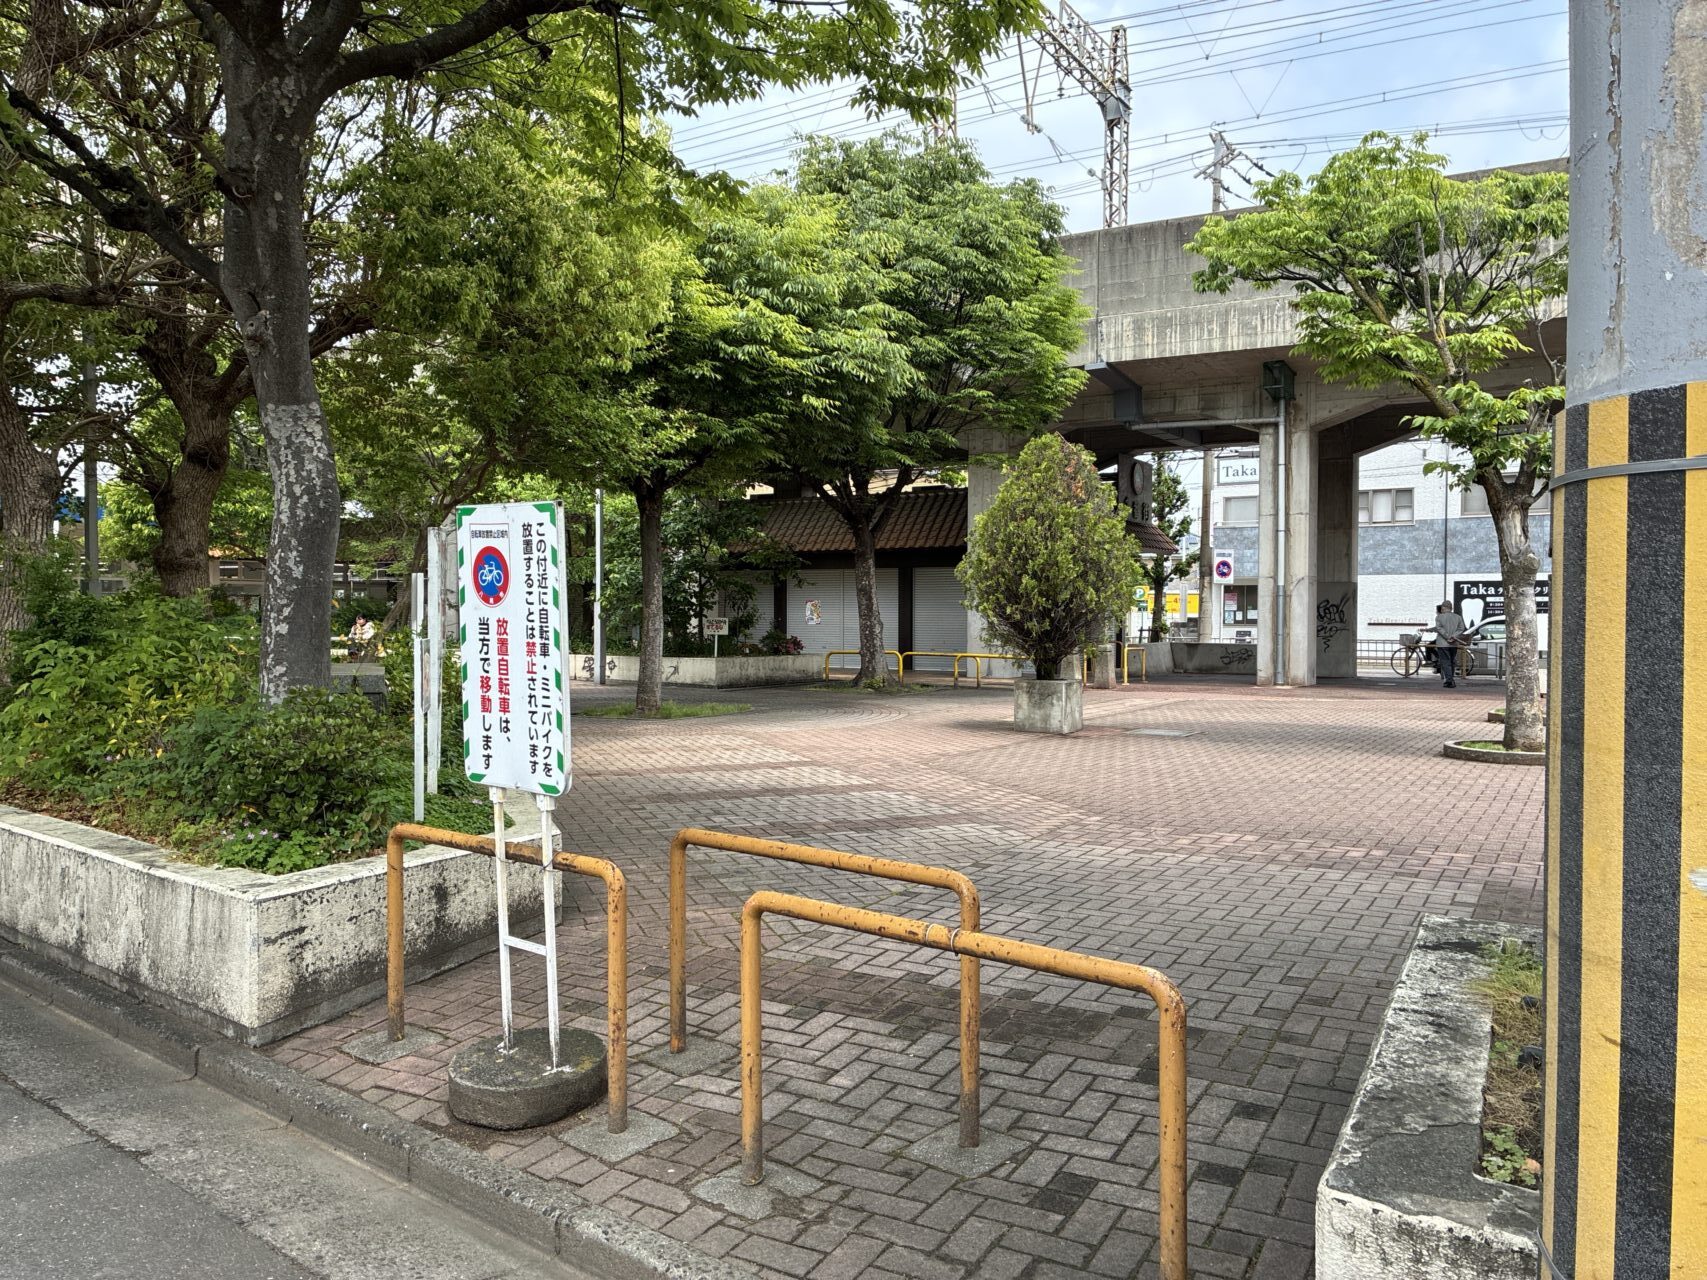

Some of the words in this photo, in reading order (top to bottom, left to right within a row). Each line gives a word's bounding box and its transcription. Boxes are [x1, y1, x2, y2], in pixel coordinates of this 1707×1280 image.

[1222, 465, 1257, 477] Taka
[521, 521, 539, 775] 放置することは禁止されています
[536, 521, 553, 778] この付近に自転車・ミニバイクを
[1460, 583, 1495, 595] Taka
[478, 616, 493, 770] 当方で移動します
[496, 617, 511, 742] 放置自転車は、
